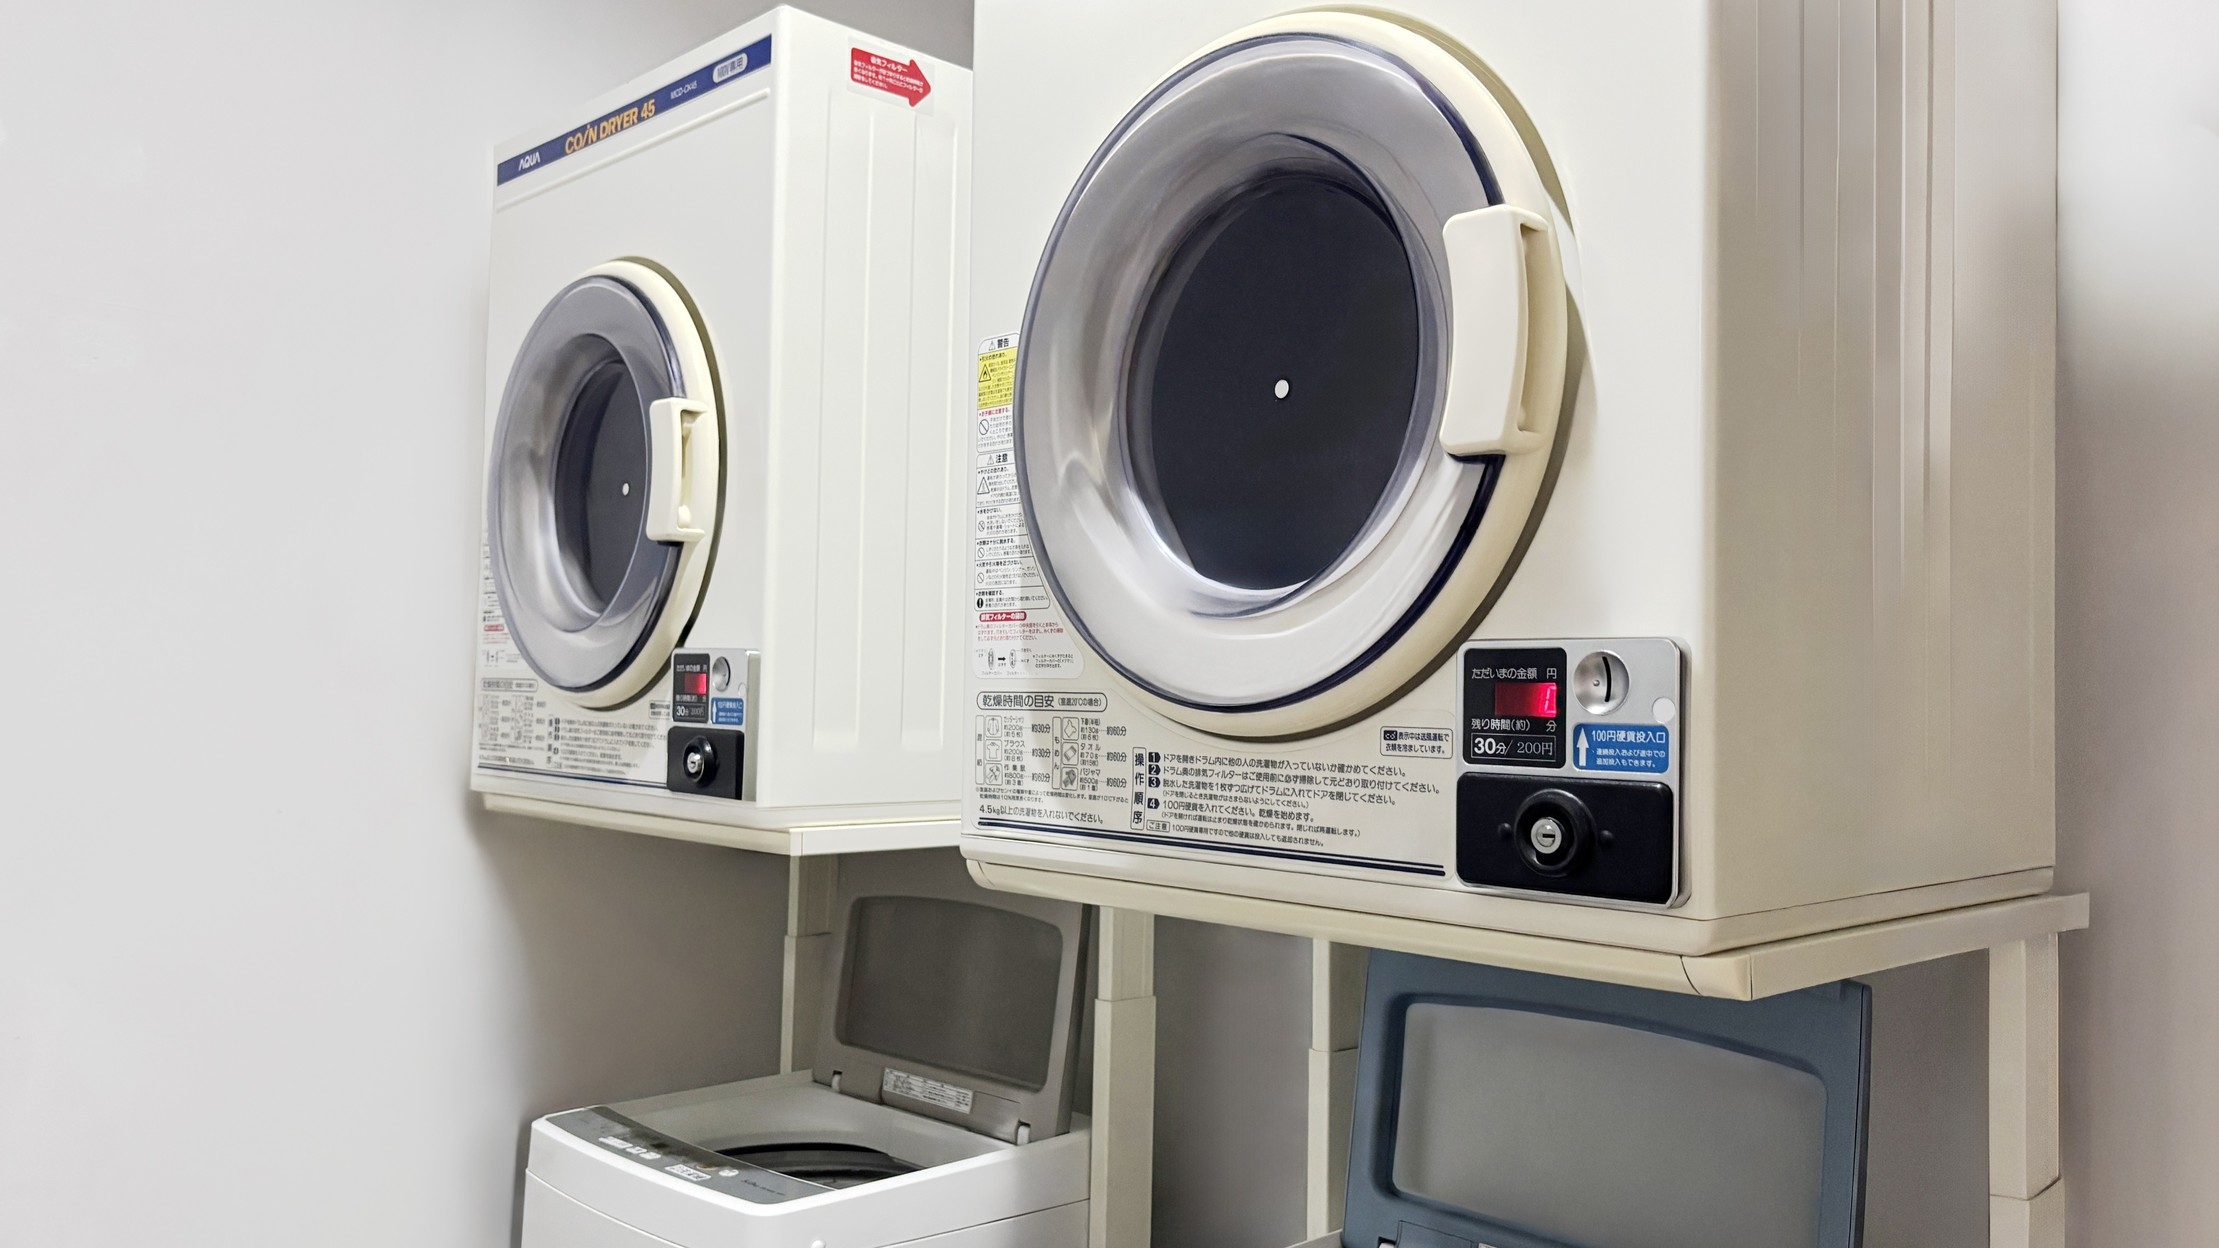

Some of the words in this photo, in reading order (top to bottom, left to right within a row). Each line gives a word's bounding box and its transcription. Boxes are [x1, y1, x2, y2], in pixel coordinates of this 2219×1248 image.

[518, 152, 540, 171] AQUA
[565, 124, 597, 155] COIN
[600, 106, 638, 140] DRYER
[640, 99, 656, 120] 45
[1472, 668, 1537, 679] ただいまの金額
[1546, 668, 1556, 679] 円
[982, 695, 1054, 708] 乾燥時間の目安
[1472, 719, 1530, 731] 残り時間(約)
[1546, 720, 1557, 732] 分
[1592, 730, 1666, 743] 100円硬貨投入口
[1386, 744, 1445, 754] 衣類を冷ましています。
[1517, 742, 1553, 755] 200円
[1133, 753, 1144, 824] 操作順序
[979, 805, 1103, 824] 4.5kg以上の洗濯物を入れないでください。
[1149, 822, 1167, 830] ご注意
